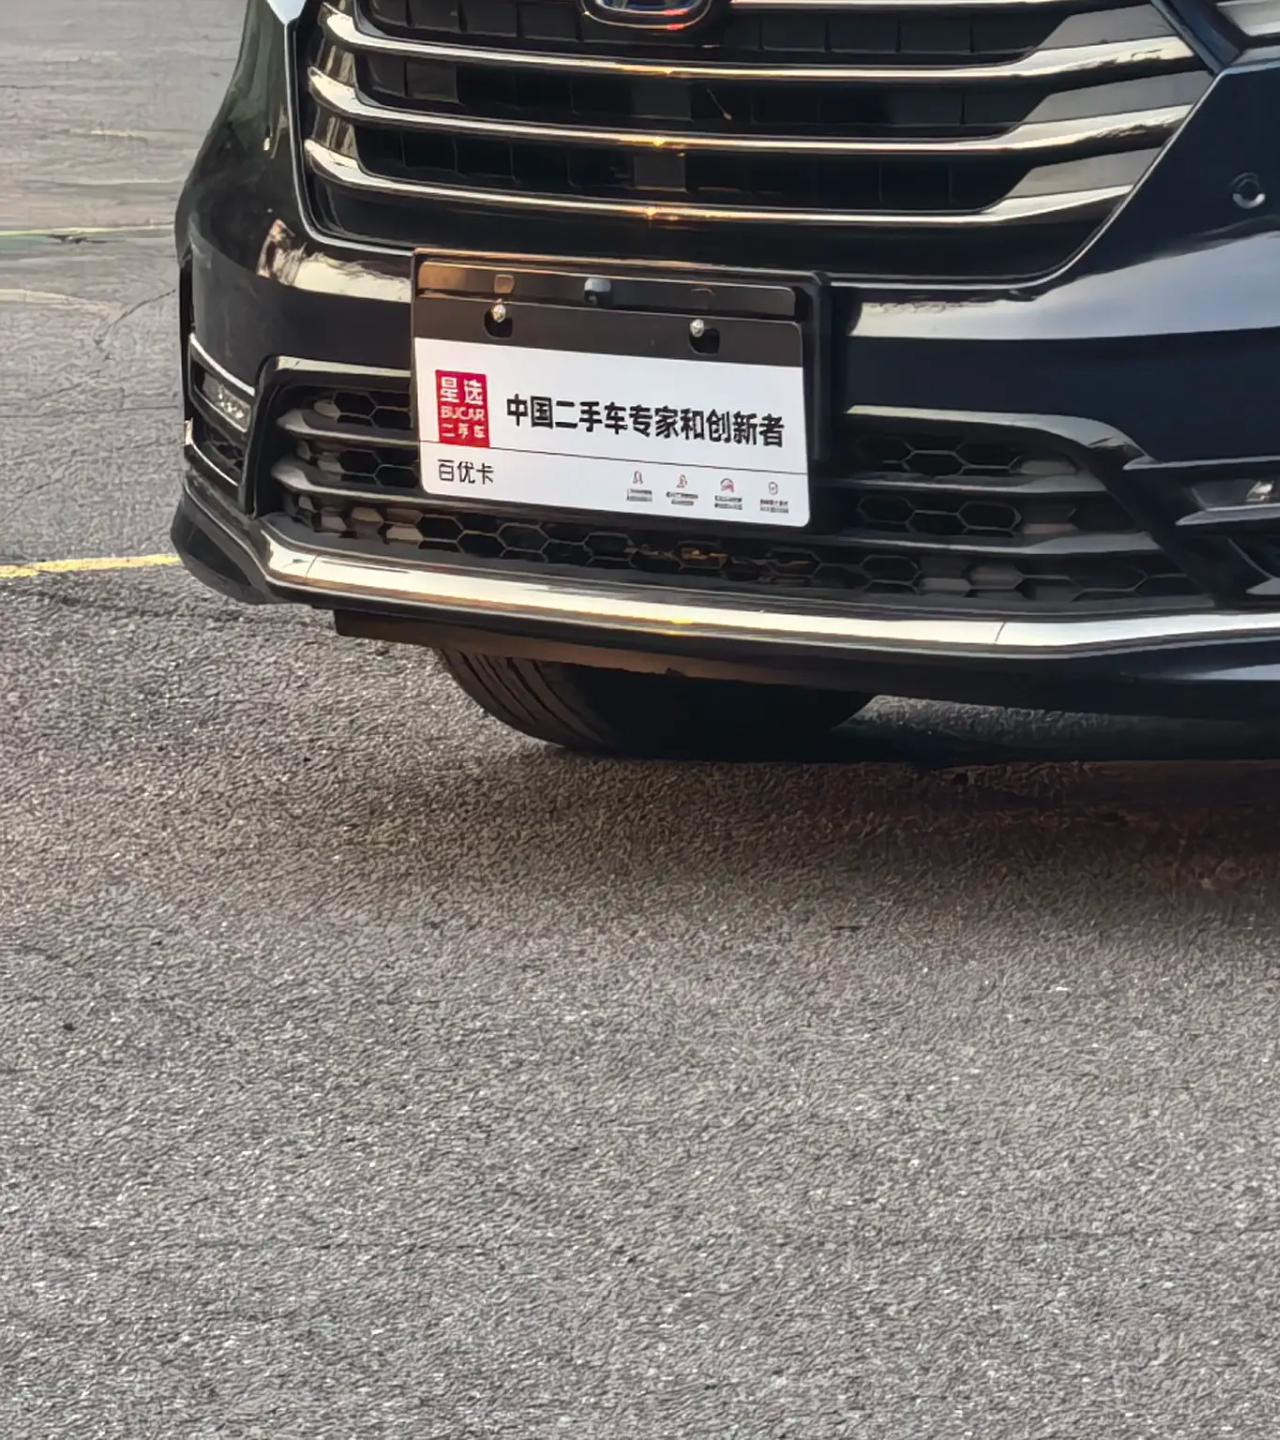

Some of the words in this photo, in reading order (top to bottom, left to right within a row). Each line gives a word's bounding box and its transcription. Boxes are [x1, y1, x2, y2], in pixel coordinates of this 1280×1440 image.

[441, 422, 486, 440] 二手车
[505, 393, 785, 448] 中国二手车专家和创新者
[437, 458, 494, 485] 百优卡
